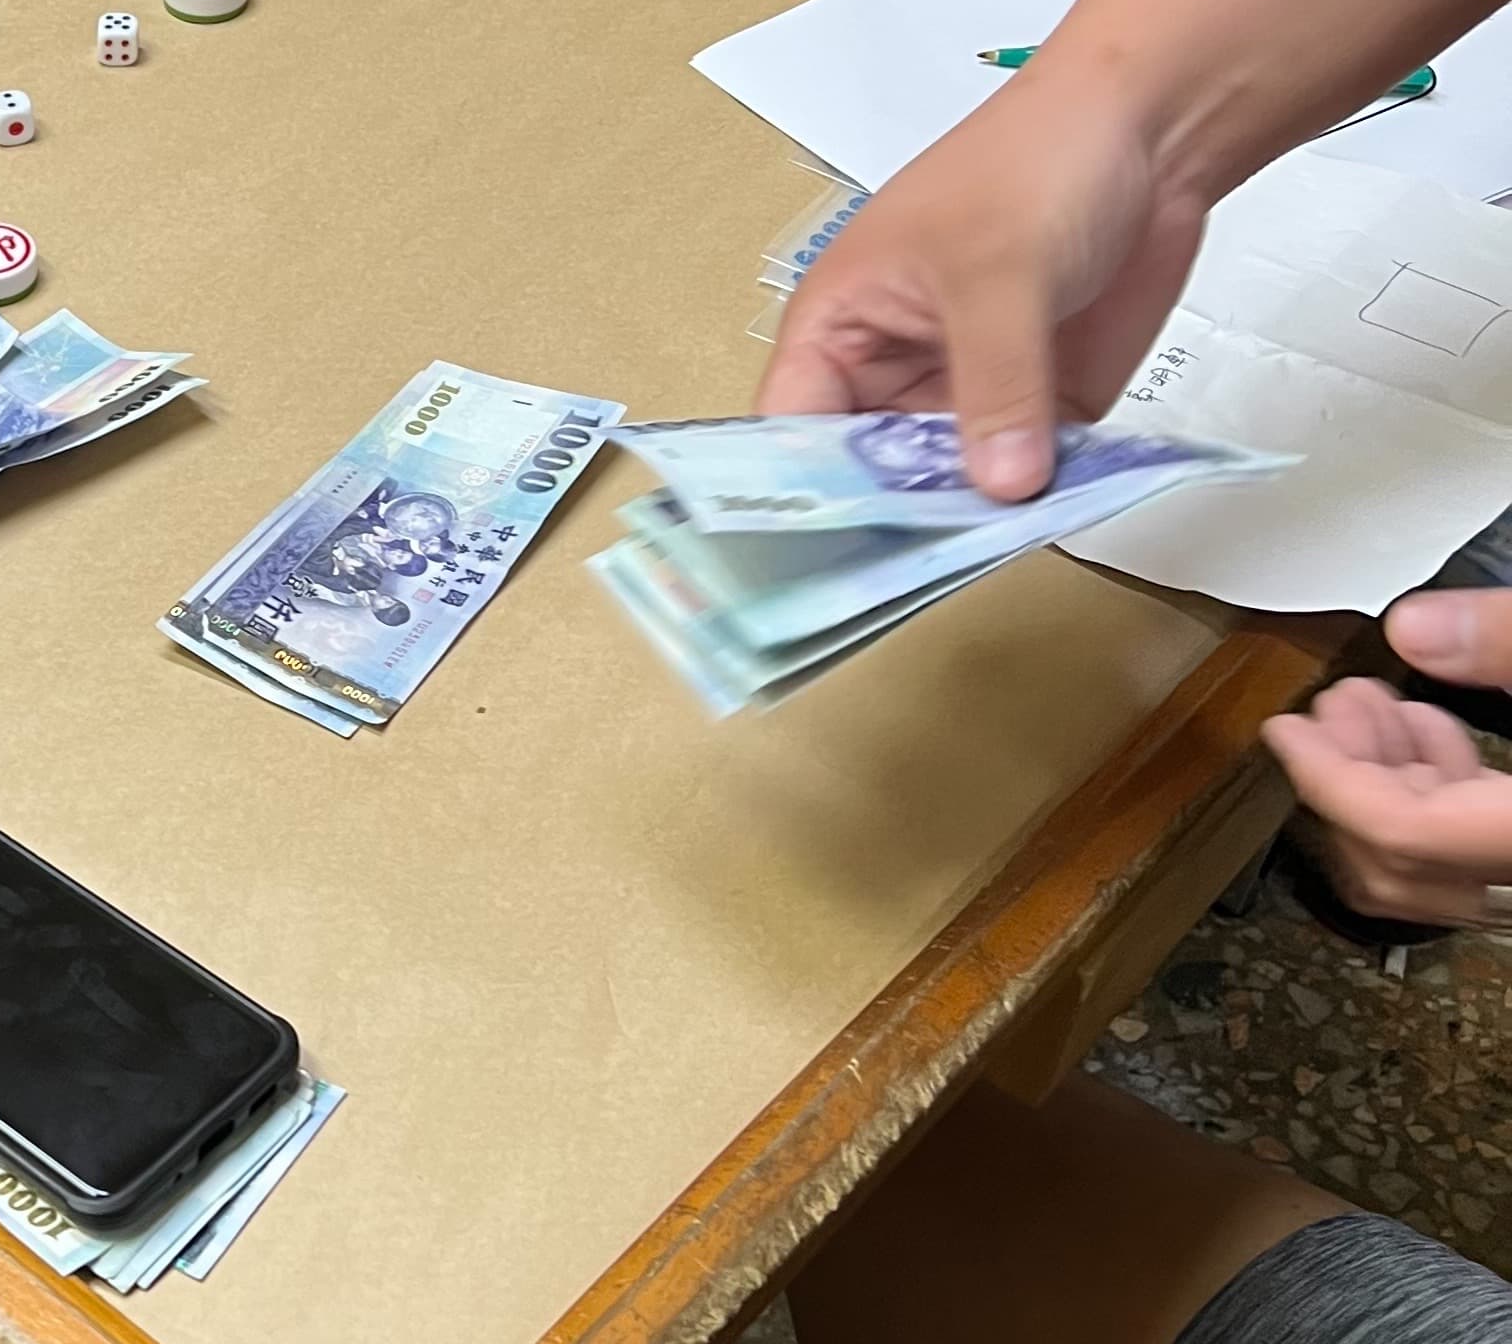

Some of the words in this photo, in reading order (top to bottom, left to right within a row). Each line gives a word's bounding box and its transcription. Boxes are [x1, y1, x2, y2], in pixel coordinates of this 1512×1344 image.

[98, 363, 164, 404] 1000
[107, 382, 177, 423] 1000
[405, 381, 461, 436] 1000
[516, 409, 604, 494] 1000
[440, 524, 519, 607] 中華民國
[342, 684, 376, 706] 1000
